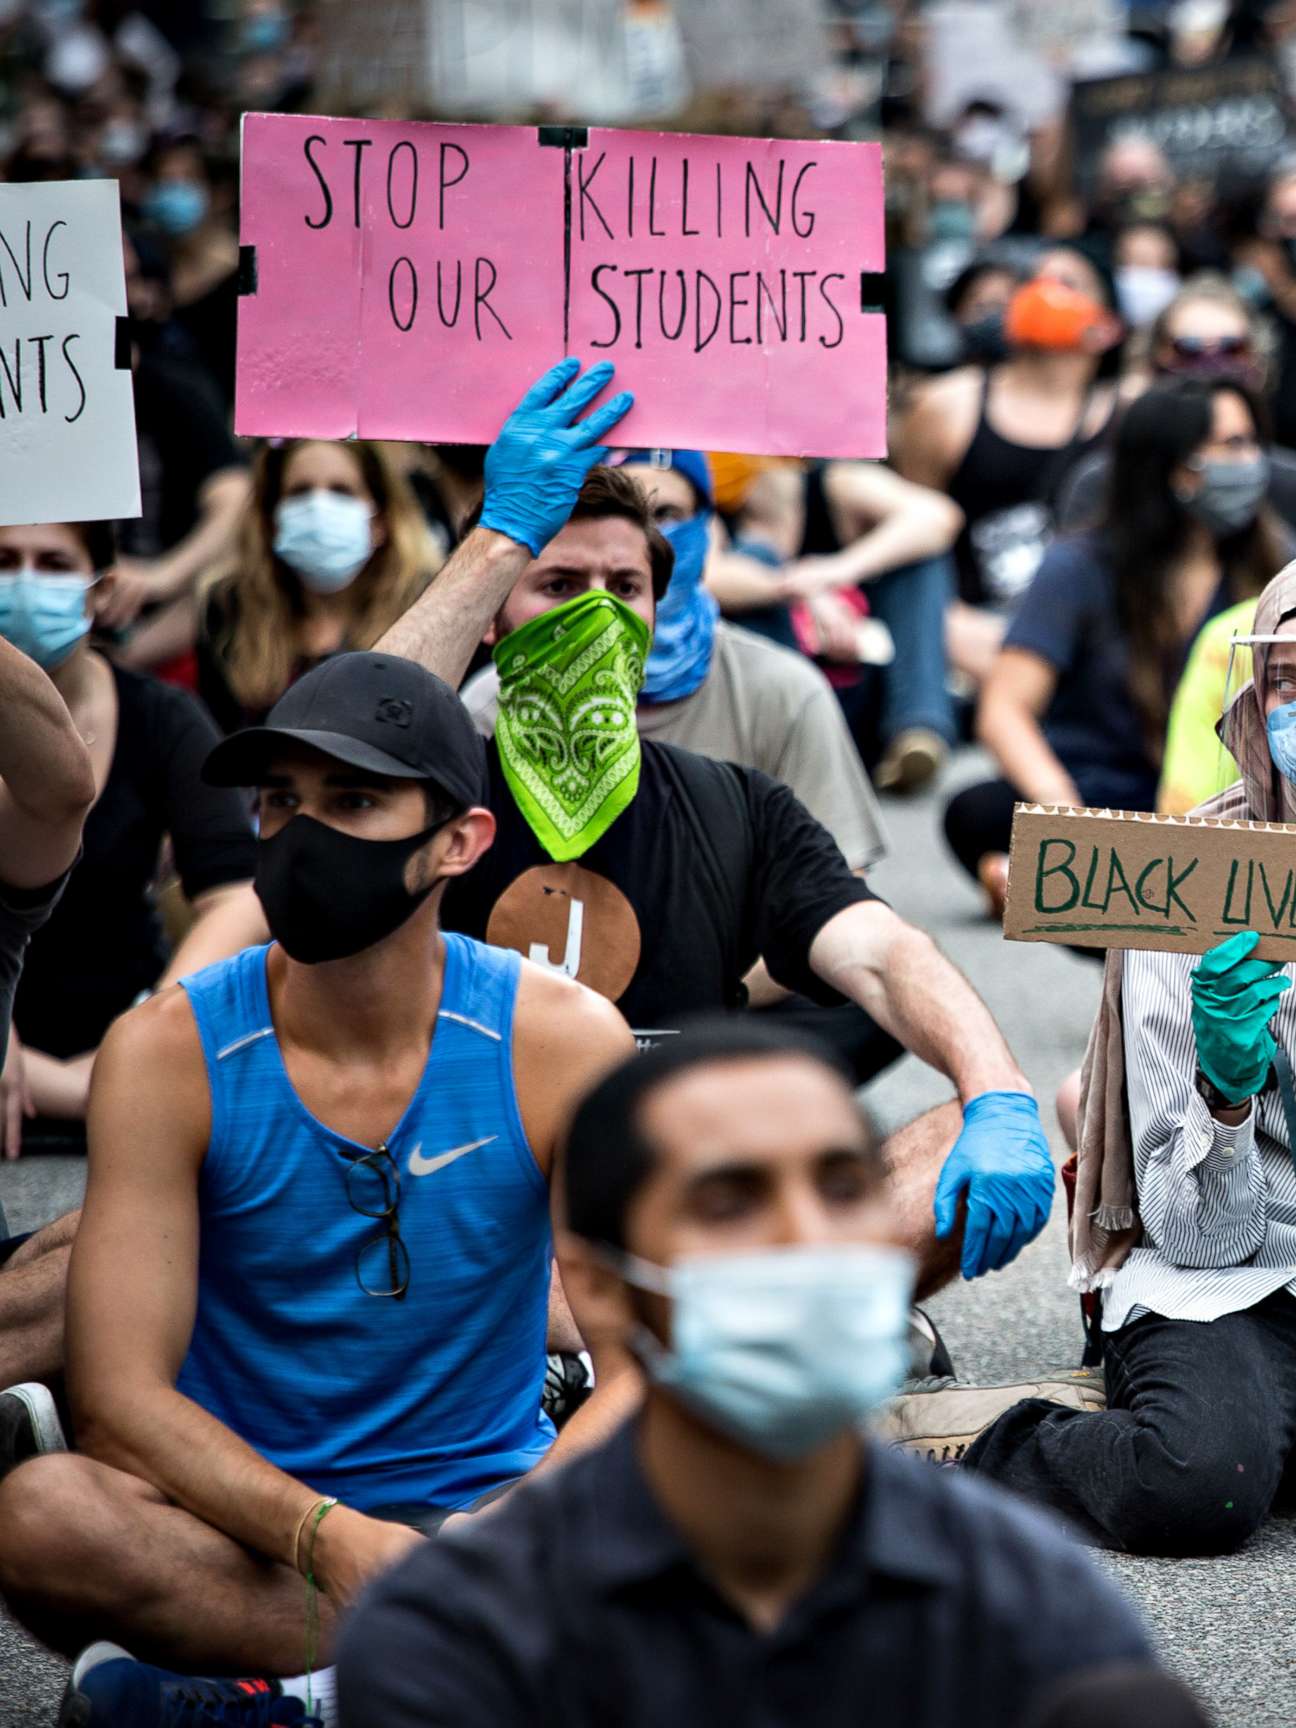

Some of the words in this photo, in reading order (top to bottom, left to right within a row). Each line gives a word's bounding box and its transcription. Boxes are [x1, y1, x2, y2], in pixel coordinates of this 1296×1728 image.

[303, 135, 470, 230] STOP
[576, 151, 818, 241] KILLING
[388, 256, 513, 341] OUR
[590, 264, 846, 353] STUDENTS
[1034, 838, 1199, 924] BLACK
